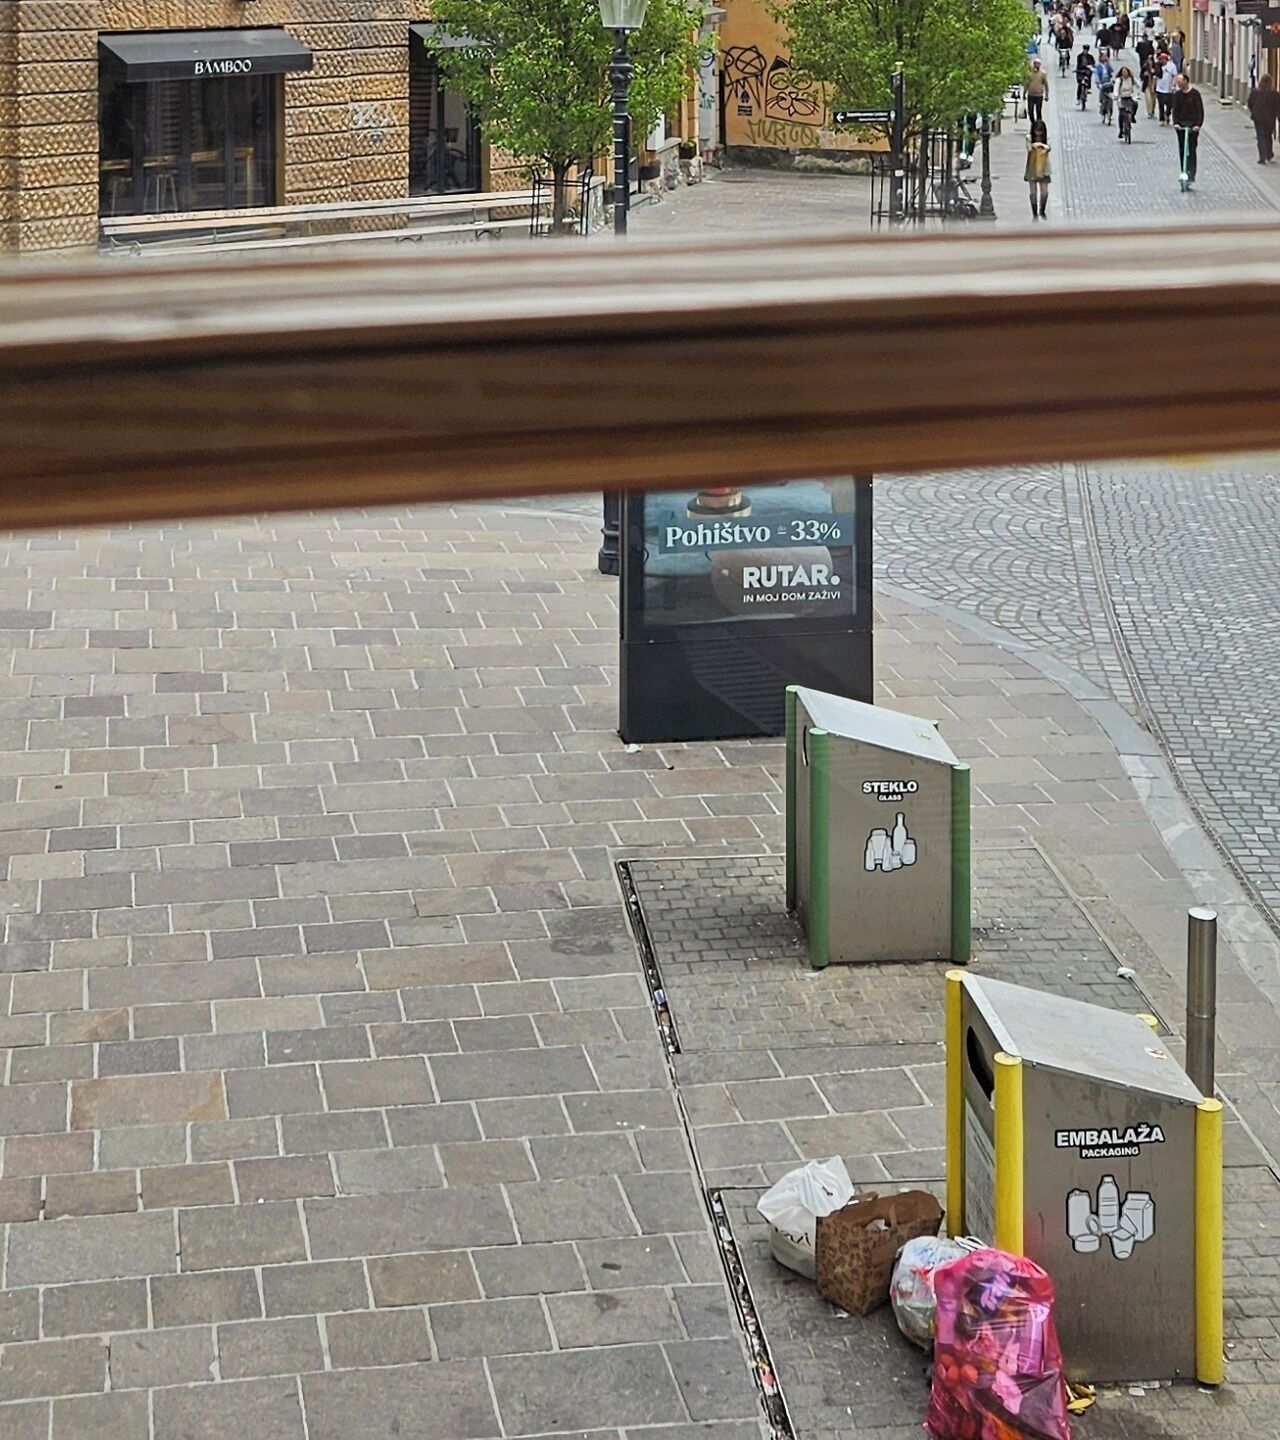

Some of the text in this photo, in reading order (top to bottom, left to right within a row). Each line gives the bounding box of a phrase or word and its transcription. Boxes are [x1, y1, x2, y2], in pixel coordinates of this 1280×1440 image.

[194, 59, 252, 74] BAMBOO
[665, 521, 771, 548] Pohištvo
[743, 590, 840, 603] IN MOJ DOM ZAŽIVI
[863, 781, 918, 793] STEKLO
[1056, 1124, 1164, 1147] EMBALAŽA
[1082, 1146, 1139, 1158] PACKAGING
